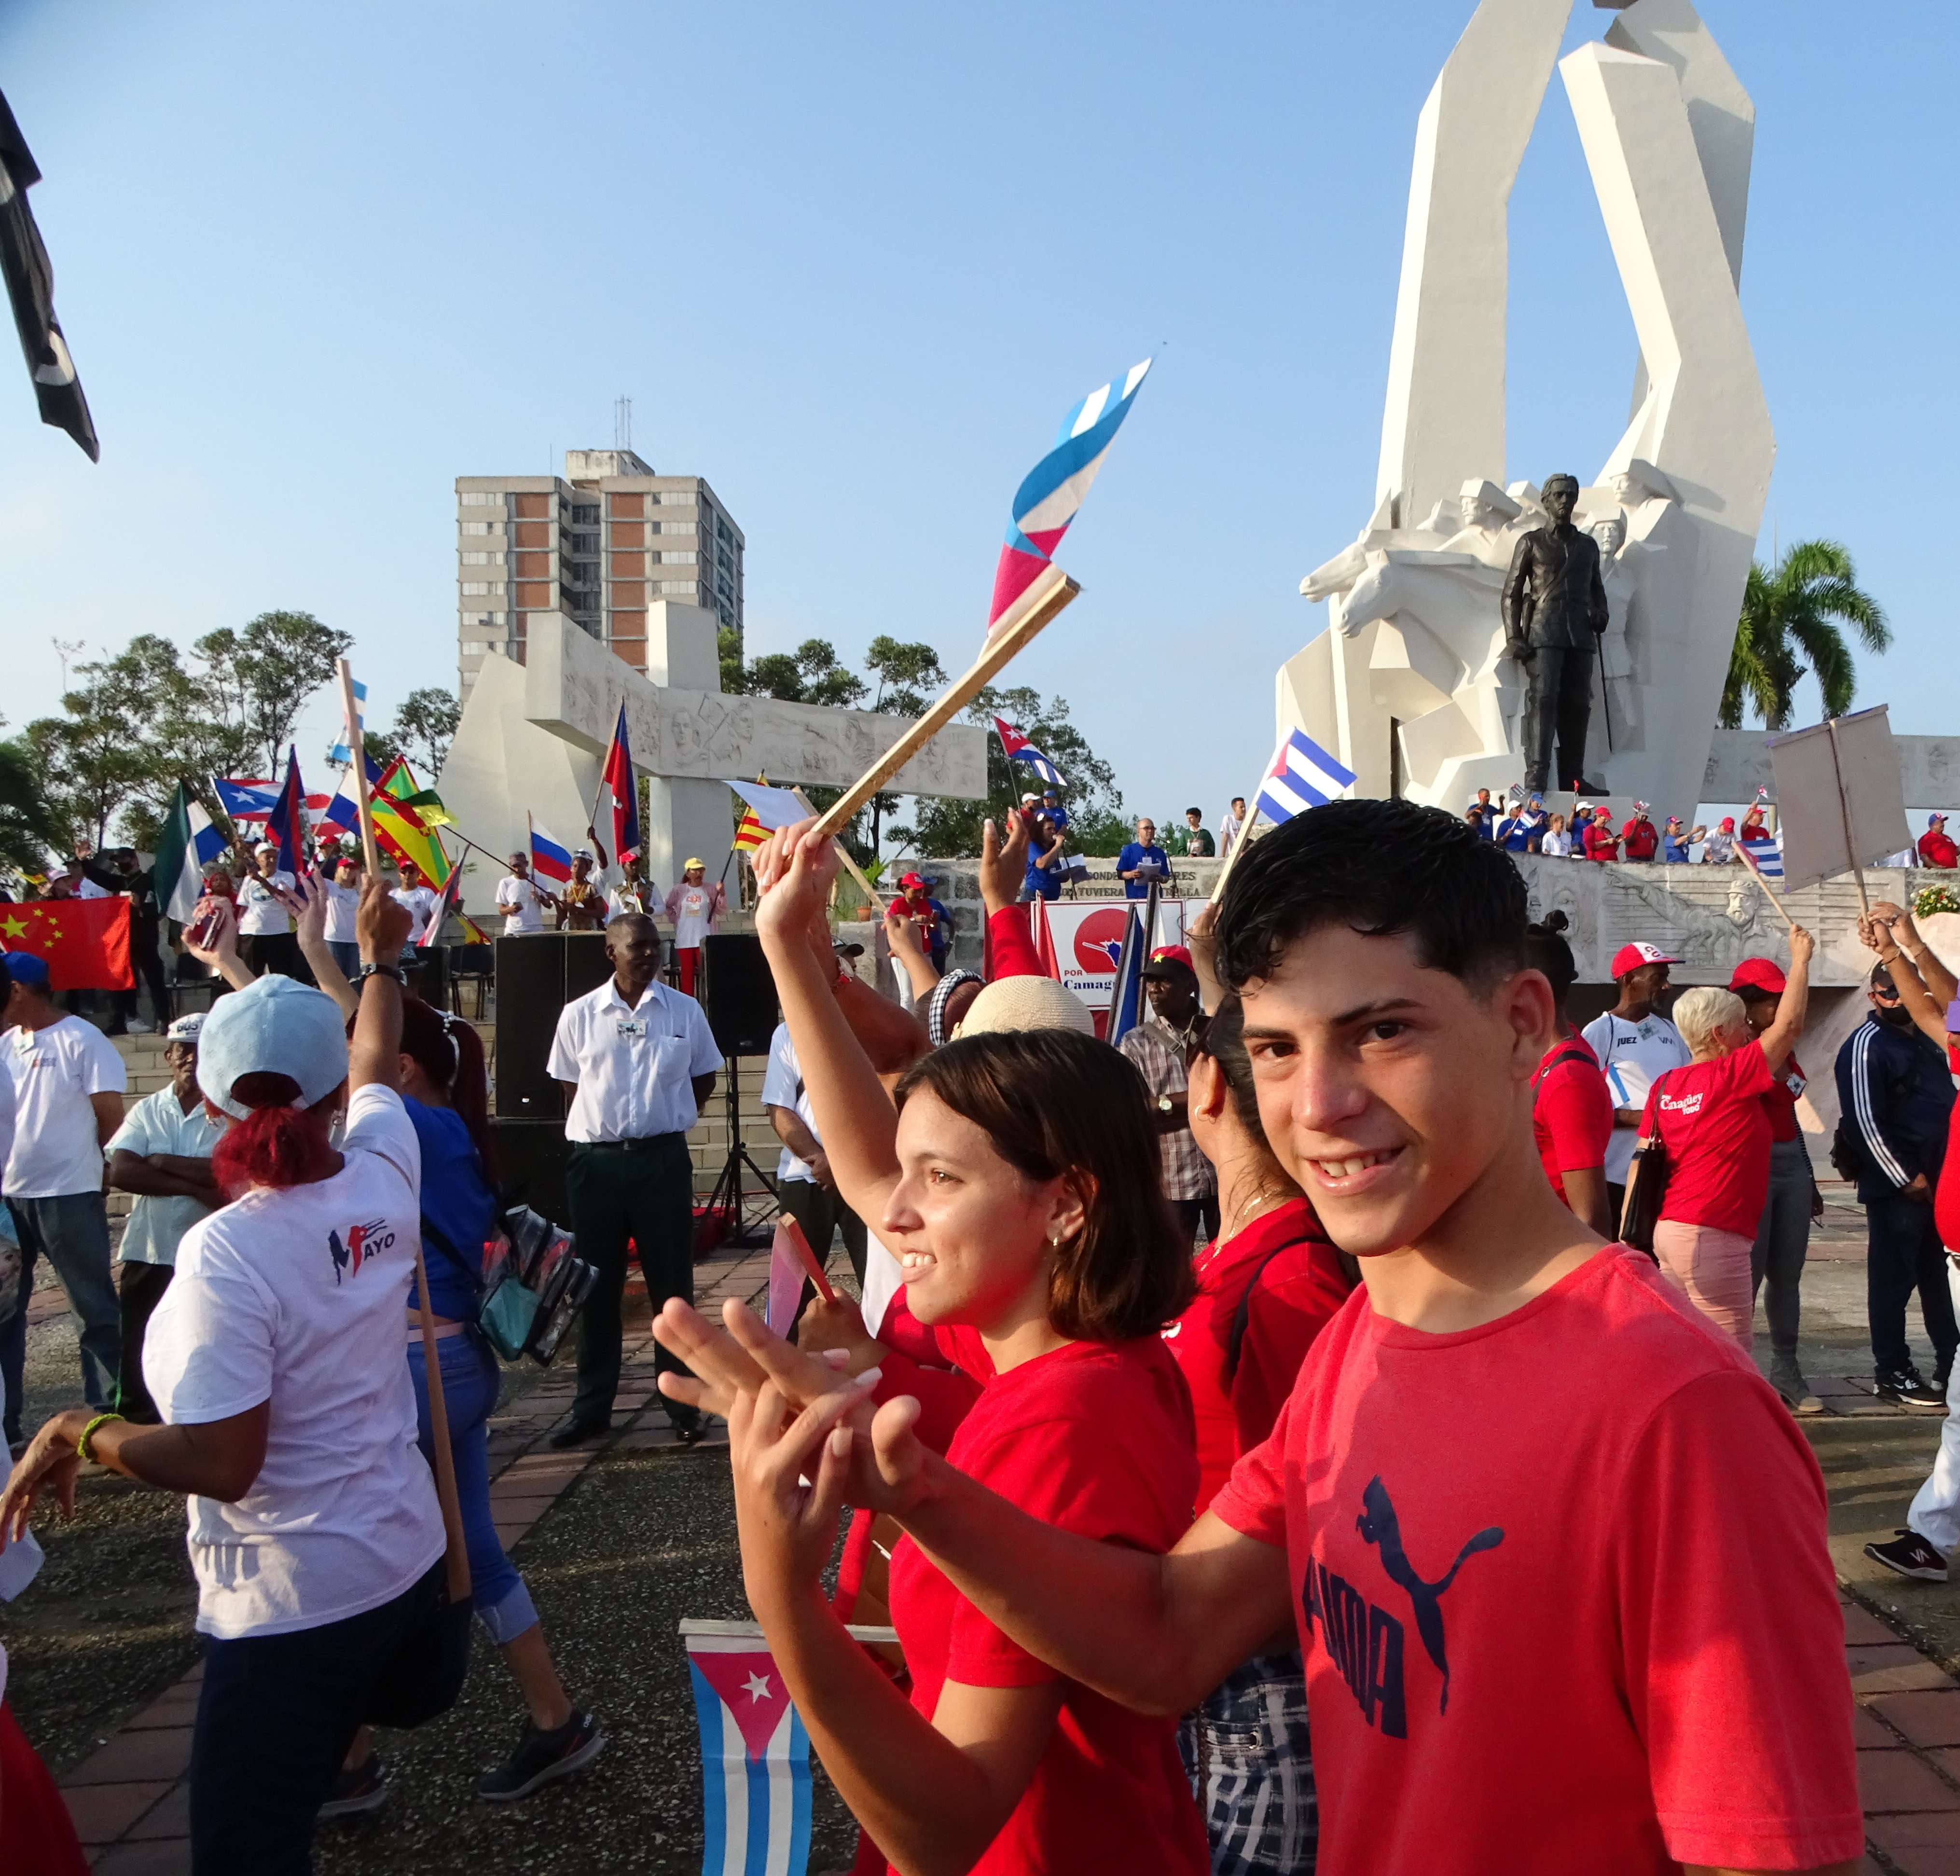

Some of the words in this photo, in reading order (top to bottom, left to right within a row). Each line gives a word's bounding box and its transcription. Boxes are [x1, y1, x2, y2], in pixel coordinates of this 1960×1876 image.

[1078, 887, 1125, 897] TUVIERA
[1617, 1037, 1637, 1048] JUEZ
[1682, 1104, 1700, 1116] TODO
